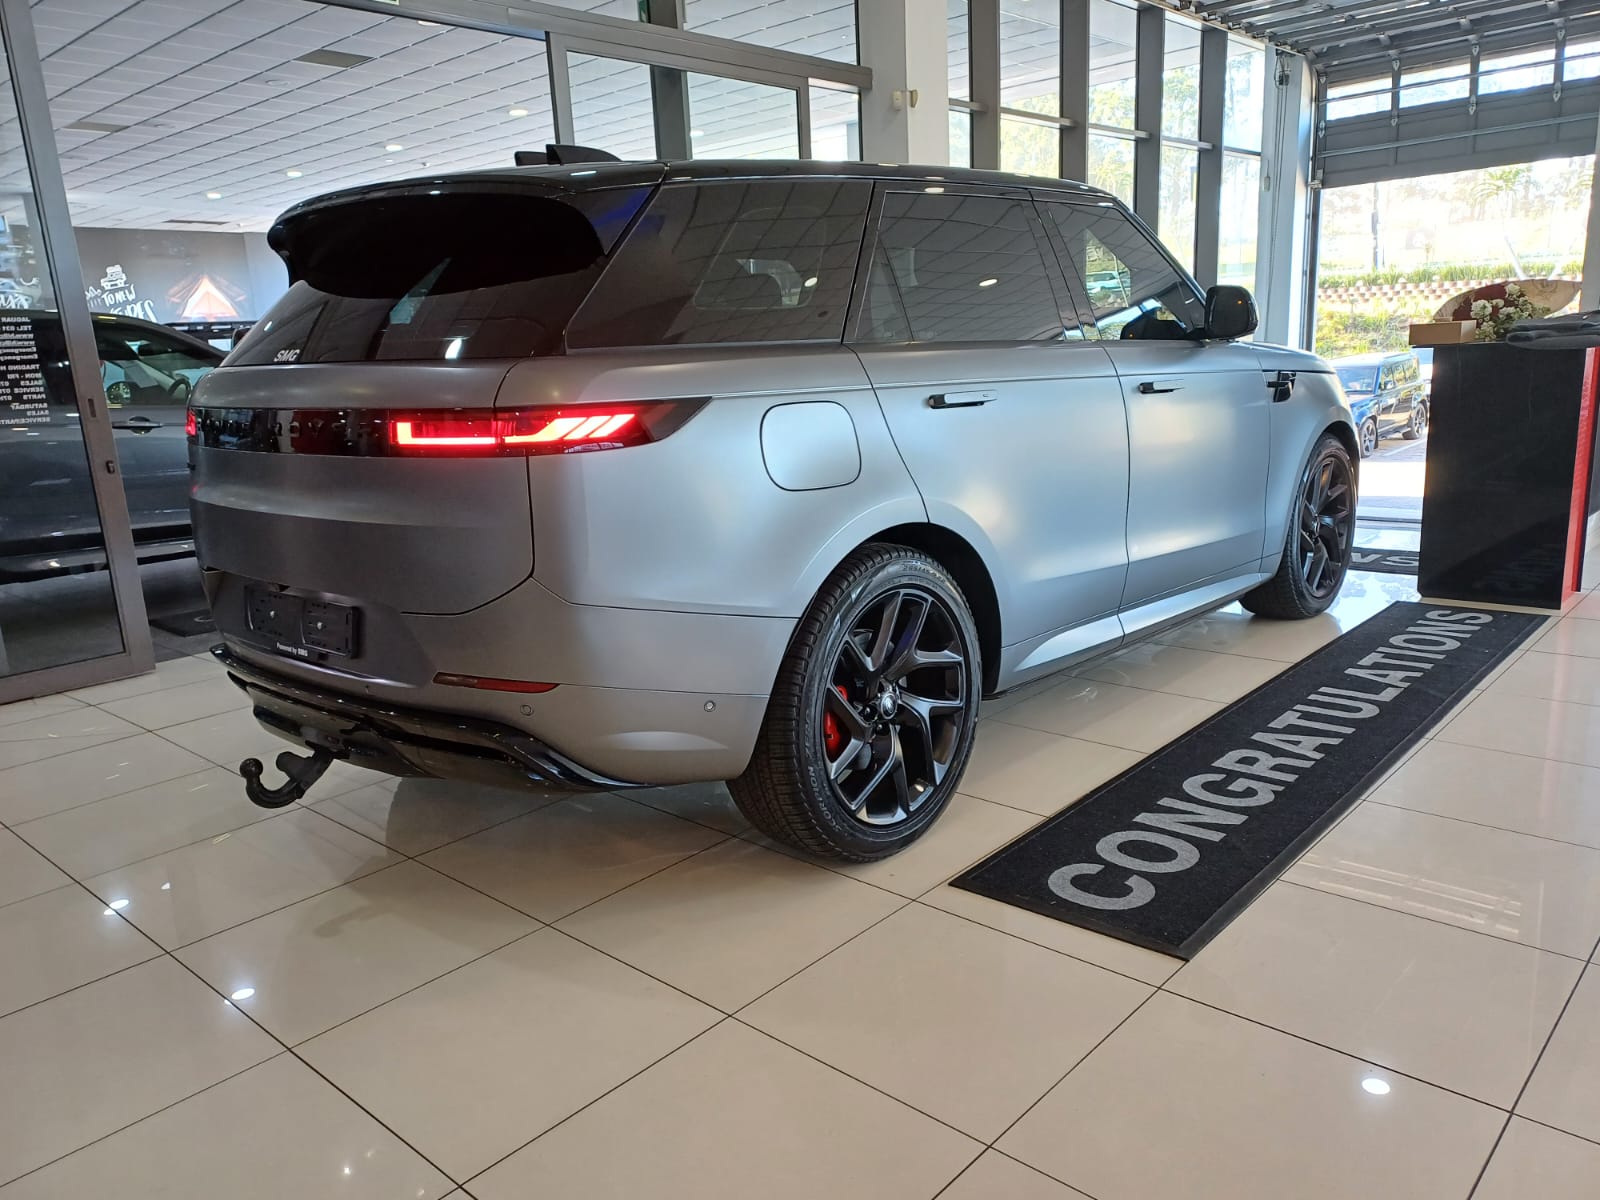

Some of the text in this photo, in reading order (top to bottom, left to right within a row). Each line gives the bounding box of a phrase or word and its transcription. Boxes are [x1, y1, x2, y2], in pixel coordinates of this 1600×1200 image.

[101, 291, 115, 307] TO
[115, 284, 136, 304] NEW
[273, 349, 300, 362] SMG
[1048, 610, 1493, 910] CONGRATULATIONS
